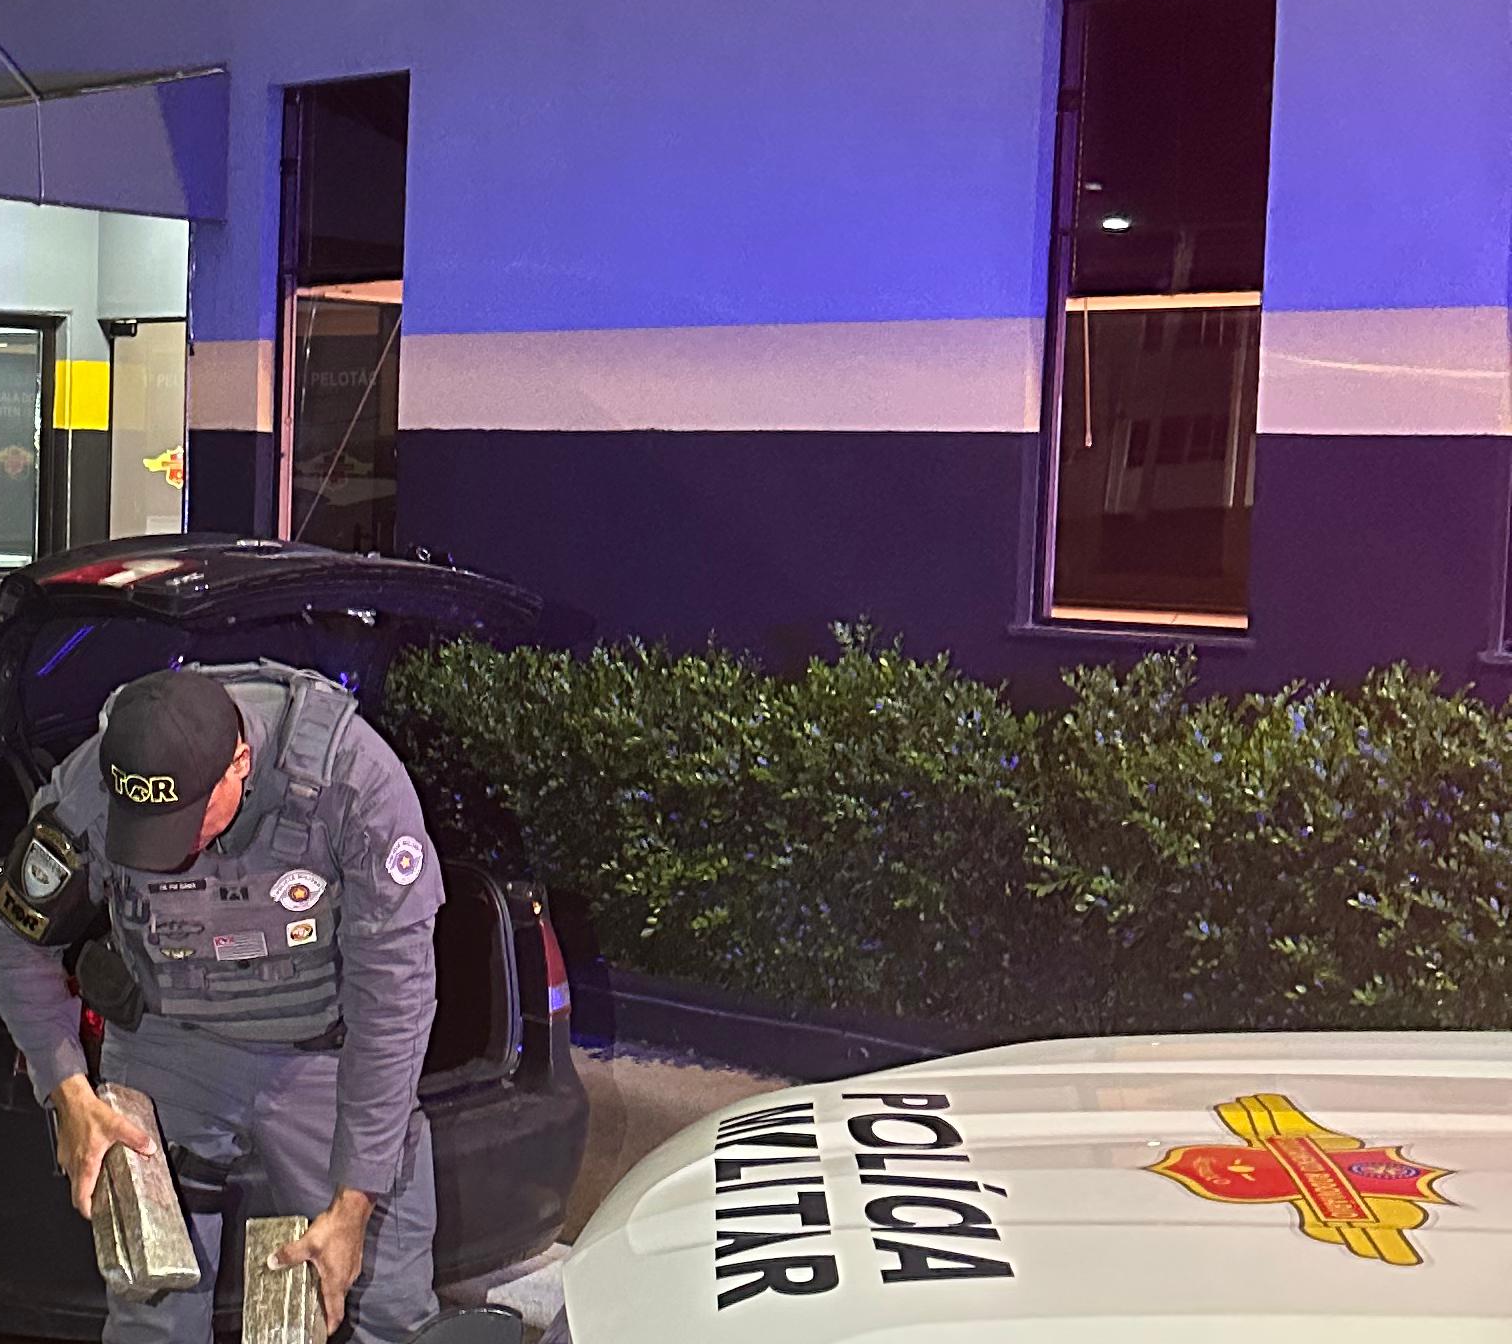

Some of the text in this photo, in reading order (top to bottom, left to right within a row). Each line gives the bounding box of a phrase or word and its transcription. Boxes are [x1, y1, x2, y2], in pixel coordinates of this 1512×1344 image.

[111, 763, 179, 804] TOR
[714, 1102, 840, 1311] MILITAR
[842, 1093, 1015, 1284] POLÍCIA
